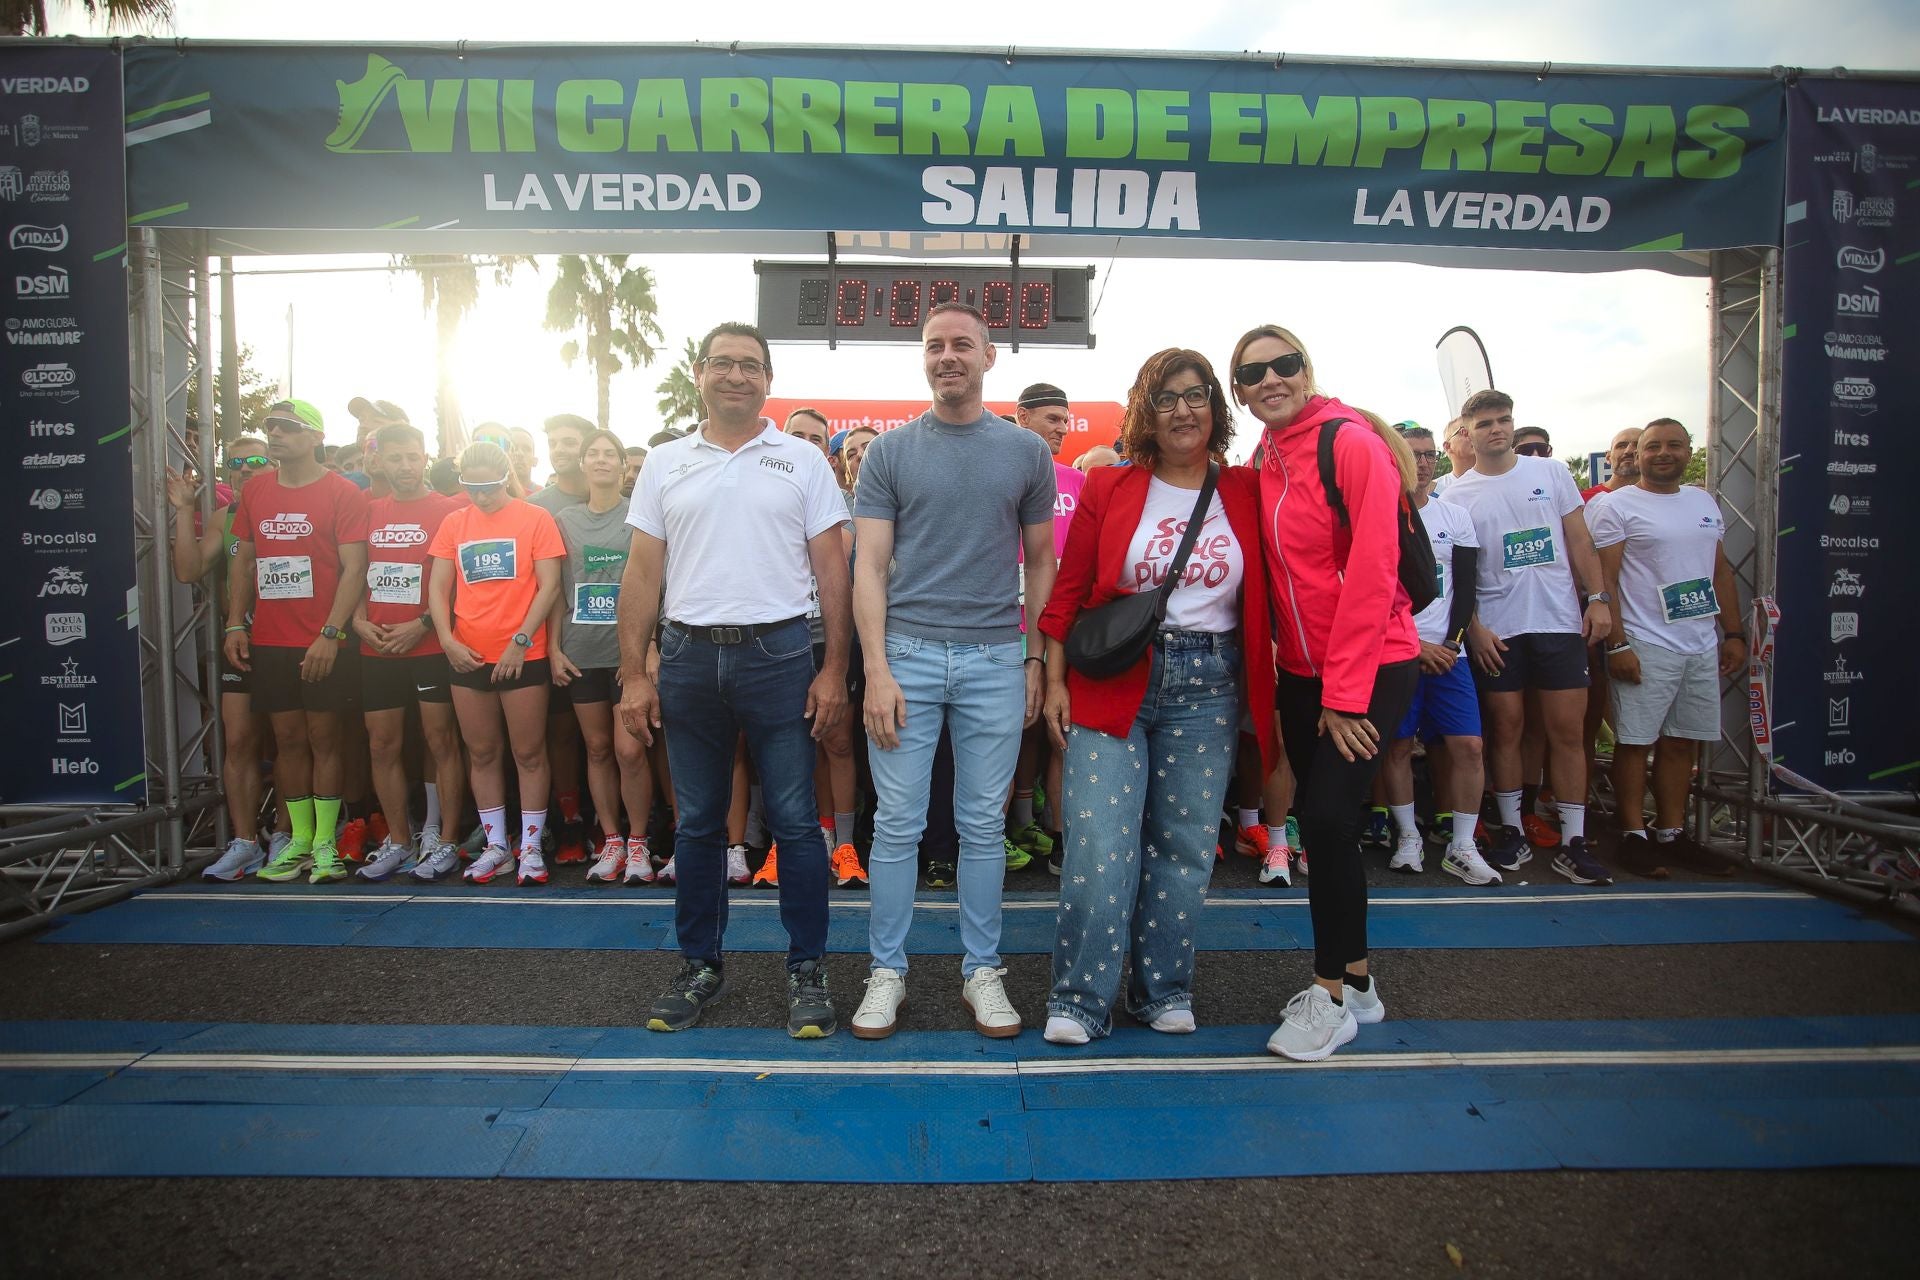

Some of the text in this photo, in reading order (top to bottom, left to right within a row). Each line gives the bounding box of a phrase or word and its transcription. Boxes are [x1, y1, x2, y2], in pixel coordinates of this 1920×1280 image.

[1, 77, 89, 94] VERDAD
[1817, 107, 1920, 125] LA VERDAD
[557, 77, 1045, 157] CARRERA
[1066, 87, 1189, 161] DE
[1208, 91, 1750, 179] EMPRESAS
[25, 183, 70, 192] ATLETISMO
[484, 174, 761, 212] LA VERDAD
[921, 166, 1200, 231] SALIDA
[1353, 188, 1610, 233] LA VERDAD
[1854, 209, 1895, 217] ATLETISMO
[17, 232, 62, 244] VIDAL
[1844, 253, 1877, 266] VIDAL
[16, 275, 69, 294] DSM
[1837, 293, 1879, 312] DSM
[46, 317, 77, 329] GLOBAL
[1855, 335, 1883, 345] GLOBAL
[30, 420, 75, 437] itres
[1834, 429, 1869, 446] itres
[22, 453, 85, 467] atalayas
[1827, 461, 1876, 474] atalayas
[29, 488, 61, 510] 40
[1829, 494, 1850, 514] 40
[22, 532, 96, 545] Brocalsa
[1820, 535, 1879, 548] Brocalsa
[1506, 539, 1545, 556] 1239
[473, 553, 501, 567] 198
[264, 572, 301, 585] 2056
[376, 575, 411, 588] 2053
[37, 581, 88, 598] jokey
[1828, 582, 1865, 597] jokey
[588, 596, 615, 609] 308
[1680, 590, 1707, 605] 534
[49, 615, 82, 625] AQUA
[1832, 615, 1855, 624] AQUA
[52, 624, 82, 634] DEUS
[41, 675, 97, 685] ESTRELLA
[1824, 671, 1864, 681] ESTRELLA
[1824, 748, 1856, 766] Hero
[52, 757, 99, 774] Hero
